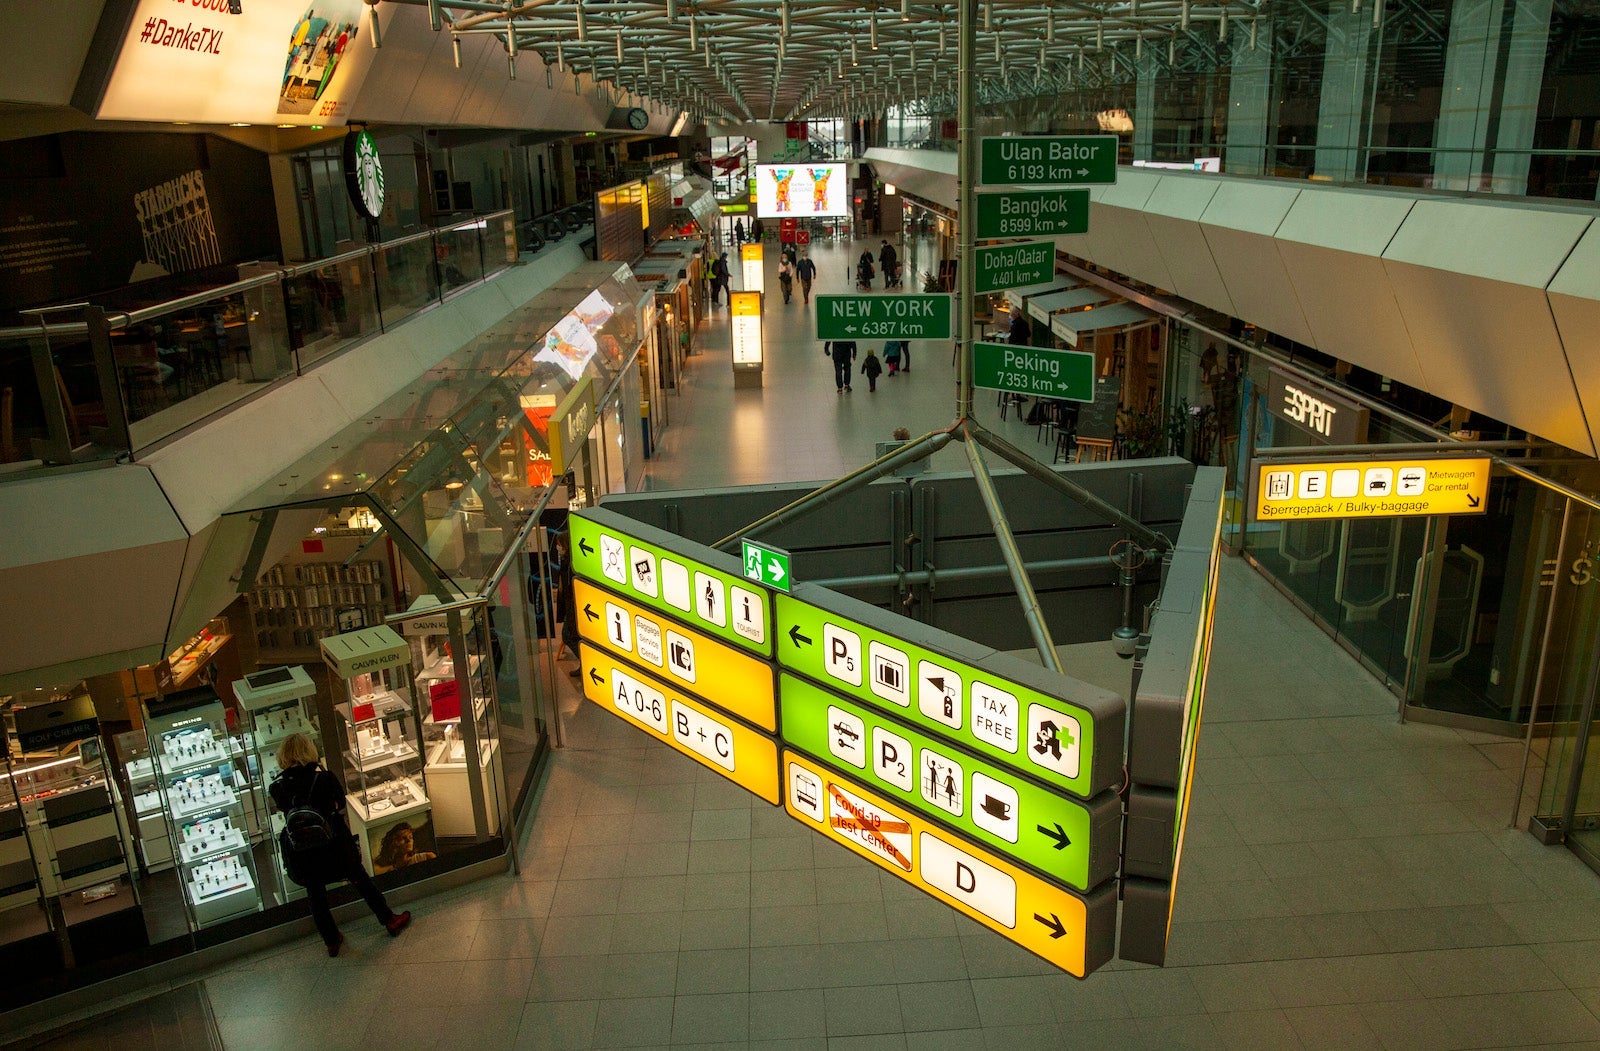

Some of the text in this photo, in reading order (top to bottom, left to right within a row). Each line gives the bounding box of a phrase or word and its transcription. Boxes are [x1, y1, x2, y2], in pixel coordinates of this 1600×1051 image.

[140, 17, 223, 54] #DankeTXL
[319, 101, 337, 117] BER
[1001, 142, 1099, 160] Ulan Bator
[1048, 165, 1072, 179] km
[134, 169, 206, 222] STARBUCKS
[1000, 195, 1068, 218] Bangkok
[1034, 218, 1054, 231] km
[984, 249, 1047, 270] Doha/Qatar
[1017, 270, 1031, 283] km
[832, 300, 935, 317] NEW YORK
[862, 322, 923, 335] 6387 km
[1004, 350, 1060, 377] Peking
[1032, 375, 1053, 391] km
[1283, 385, 1337, 437] ESPRIT
[529, 448, 552, 461] SAL
[1307, 477, 1319, 492] E
[1430, 471, 1475, 481] Mietwagen
[1428, 483, 1469, 492] Car rental
[1262, 503, 1334, 516] Sperrgepäck
[1346, 501, 1430, 513] Bulky-baggage
[636, 619, 660, 637] Baggage
[737, 622, 760, 637] TOURIST
[639, 633, 659, 650] Service
[352, 653, 400, 671] CALVIN KLEIN
[641, 647, 660, 662] Center
[618, 681, 662, 722] A 0-6
[981, 695, 1008, 717] TAX
[677, 711, 690, 737] B
[714, 732, 729, 758] C
[977, 716, 1012, 741] FREE
[835, 794, 880, 827] Covid-19
[835, 813, 898, 857] Test Center
[956, 862, 976, 893] D
